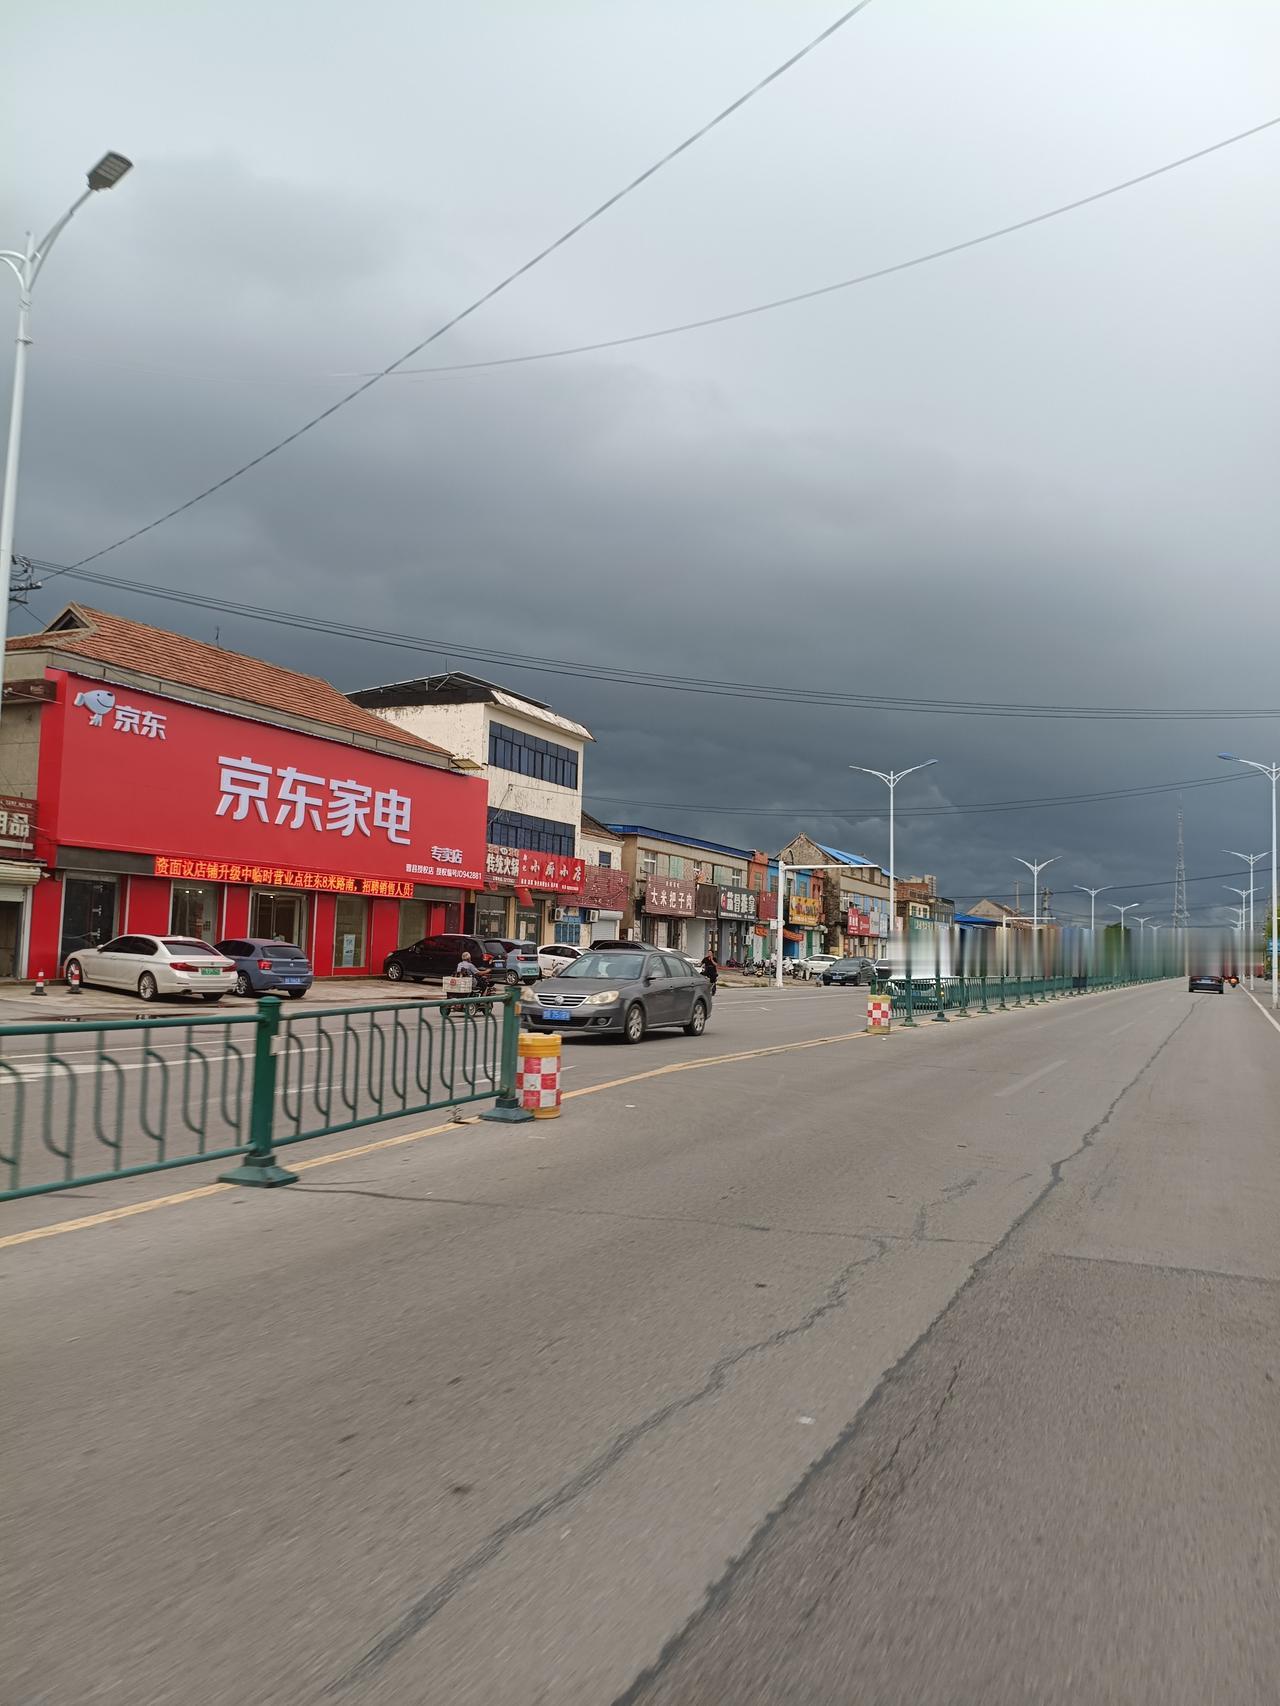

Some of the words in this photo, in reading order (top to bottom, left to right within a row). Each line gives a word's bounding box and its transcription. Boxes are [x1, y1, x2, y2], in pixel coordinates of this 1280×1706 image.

[113, 704, 167, 740] 京东
[215, 756, 412, 845] 京东家电
[431, 846, 463, 864] 专卖店
